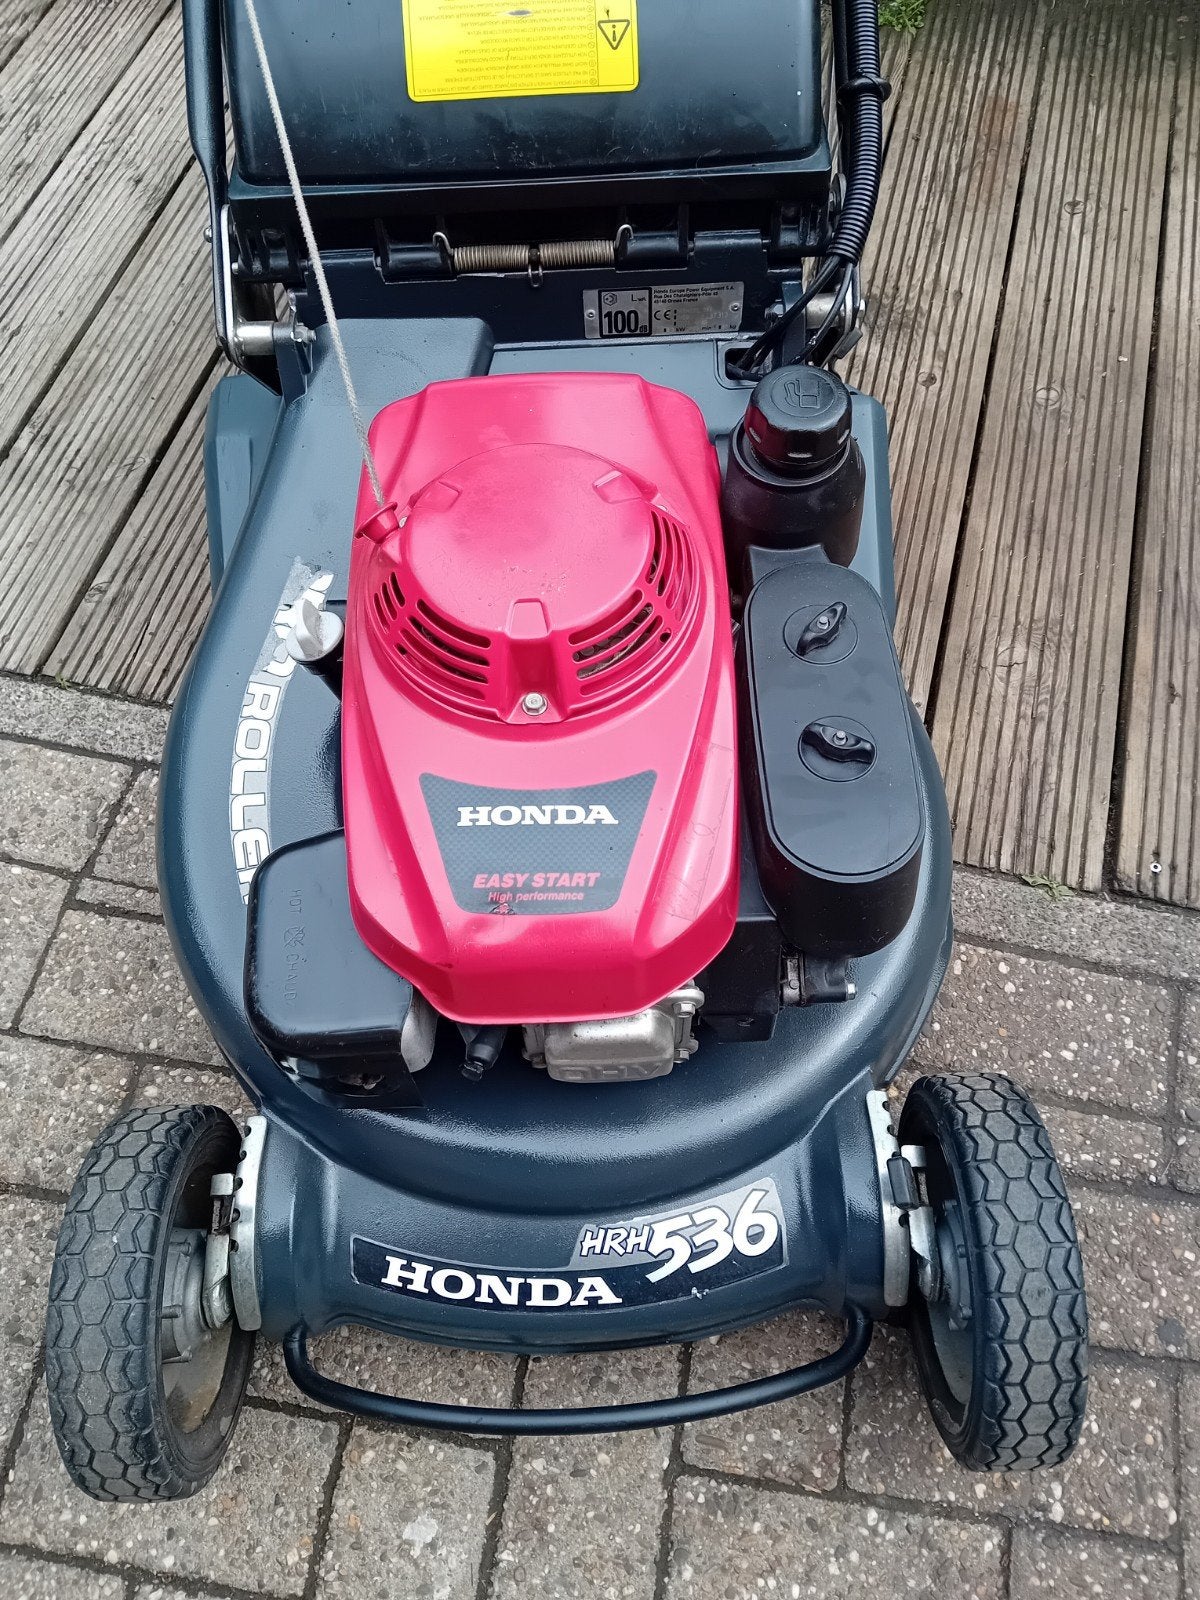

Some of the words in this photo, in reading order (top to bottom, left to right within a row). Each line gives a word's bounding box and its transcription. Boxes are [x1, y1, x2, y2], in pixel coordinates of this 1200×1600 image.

[456, 804, 619, 827] HONDA
[472, 873, 530, 889] EASY
[531, 872, 601, 888] START
[488, 892, 513, 903] High
[516, 892, 584, 902] performance
[381, 1254, 623, 1307] HONDA
